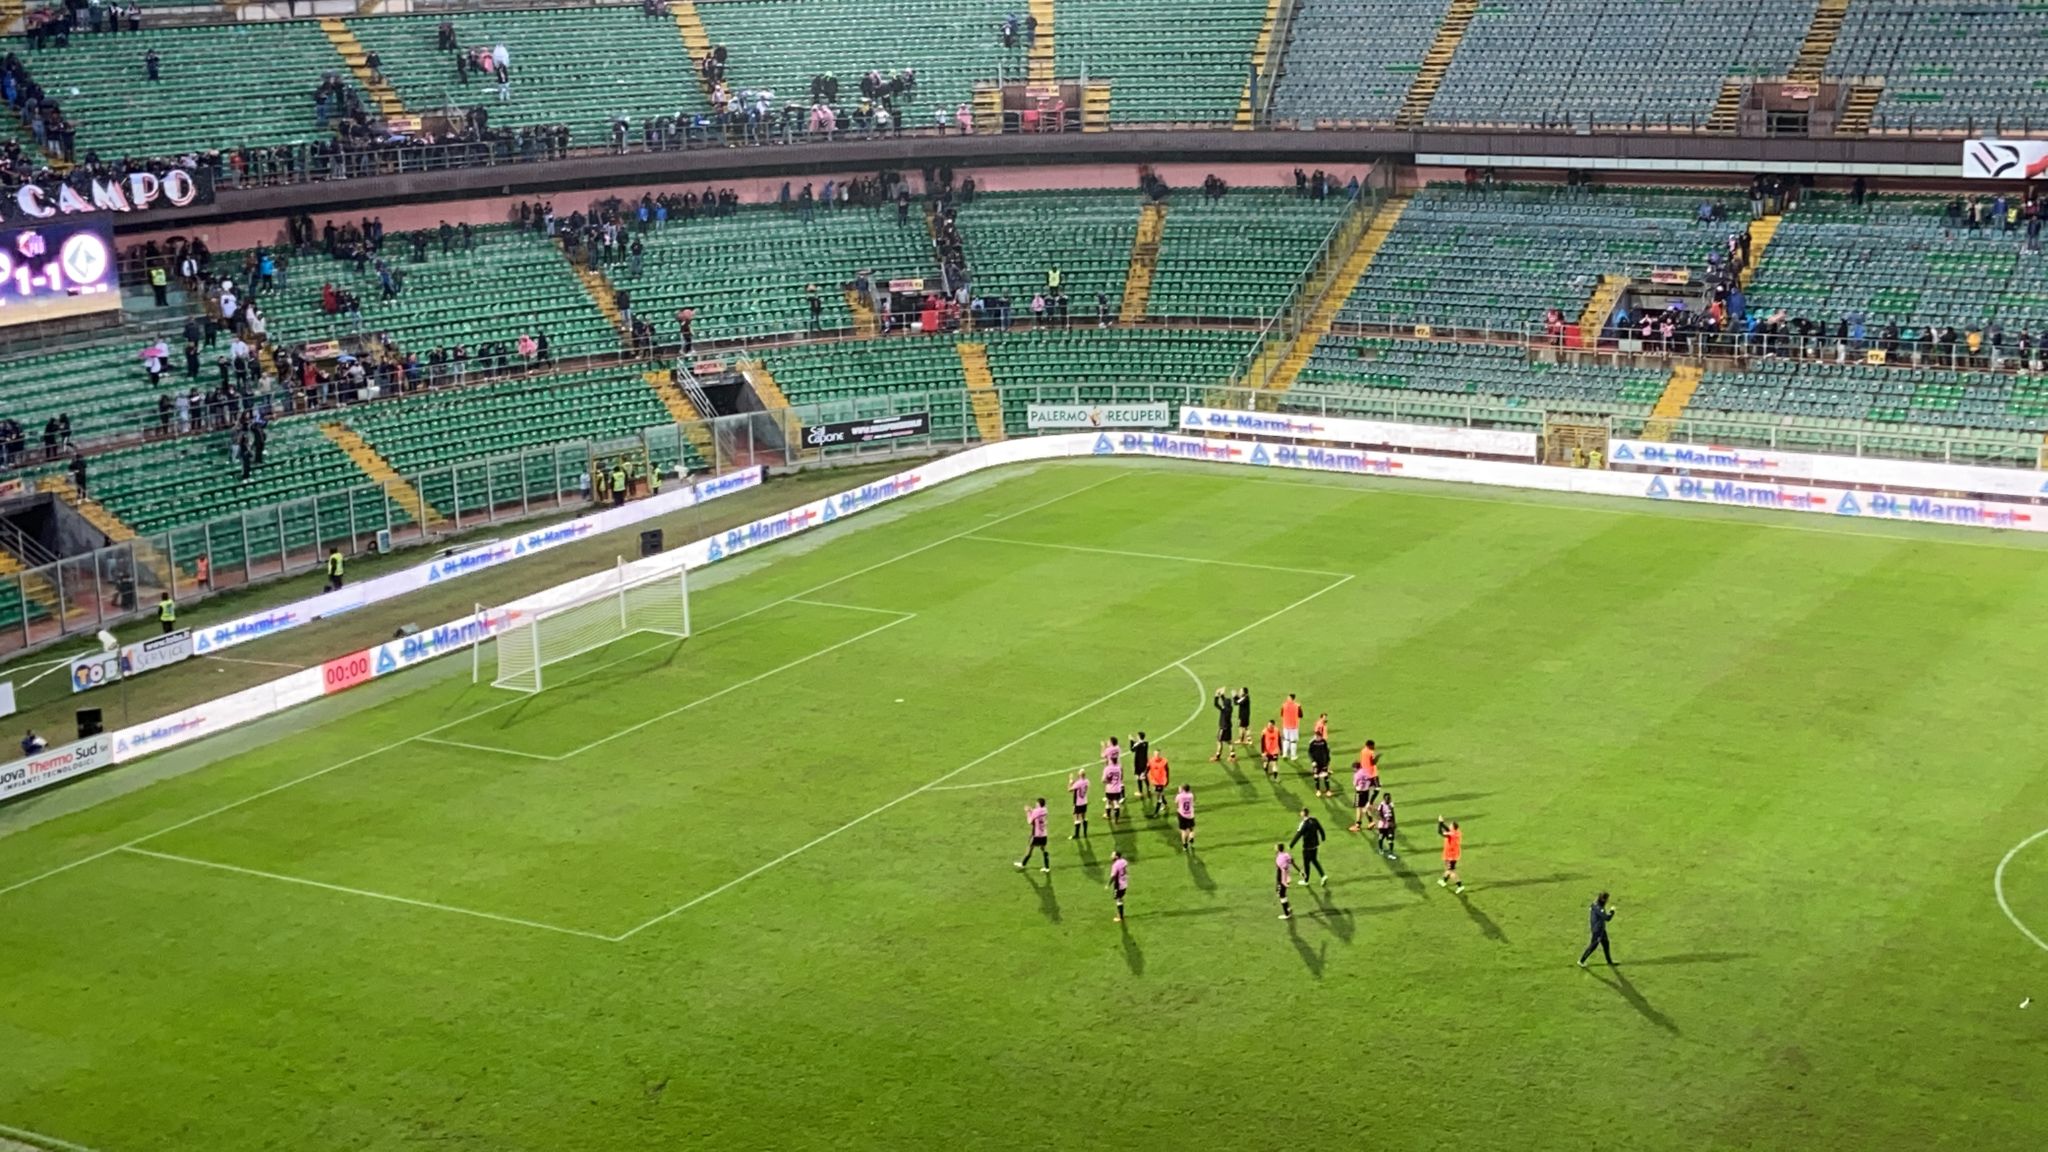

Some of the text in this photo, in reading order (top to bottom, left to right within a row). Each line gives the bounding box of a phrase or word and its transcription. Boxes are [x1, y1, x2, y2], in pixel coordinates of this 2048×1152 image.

[17, 169, 196, 218] CAMPO
[15, 262, 62, 296] 1-1
[1031, 408, 1166, 423] PALERMO RECUPERI
[1675, 448, 1739, 468] Marmi
[1713, 480, 1784, 507] Marmi
[1908, 497, 1986, 524] Marmi
[326, 657, 368, 685] 00:00
[27, 753, 74, 774] Thermo
[75, 742, 98, 760] Sud
[43, 758, 94, 778] TECNOLOGICI
